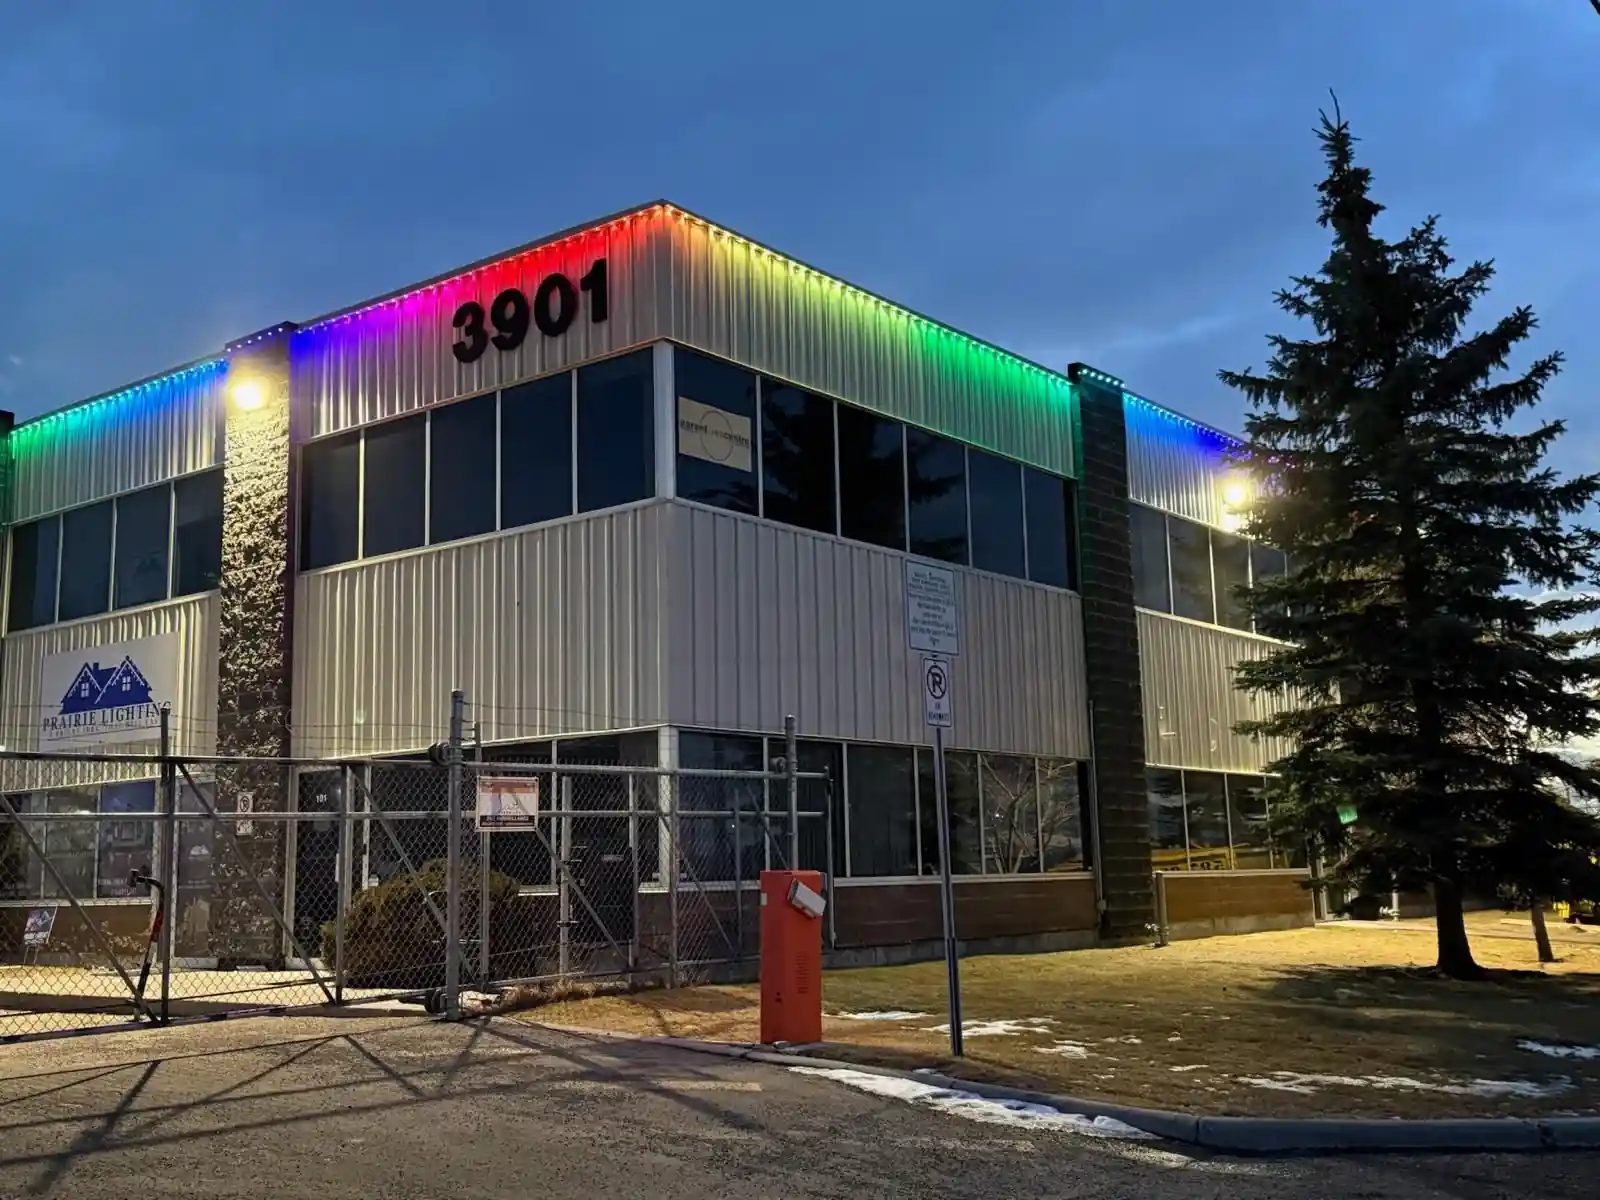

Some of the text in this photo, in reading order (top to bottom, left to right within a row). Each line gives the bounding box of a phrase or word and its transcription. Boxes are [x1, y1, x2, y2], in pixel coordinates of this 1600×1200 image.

[452, 257, 607, 363] 3901
[43, 711, 97, 732] PRAIRIE
[316, 794, 327, 803] 101
